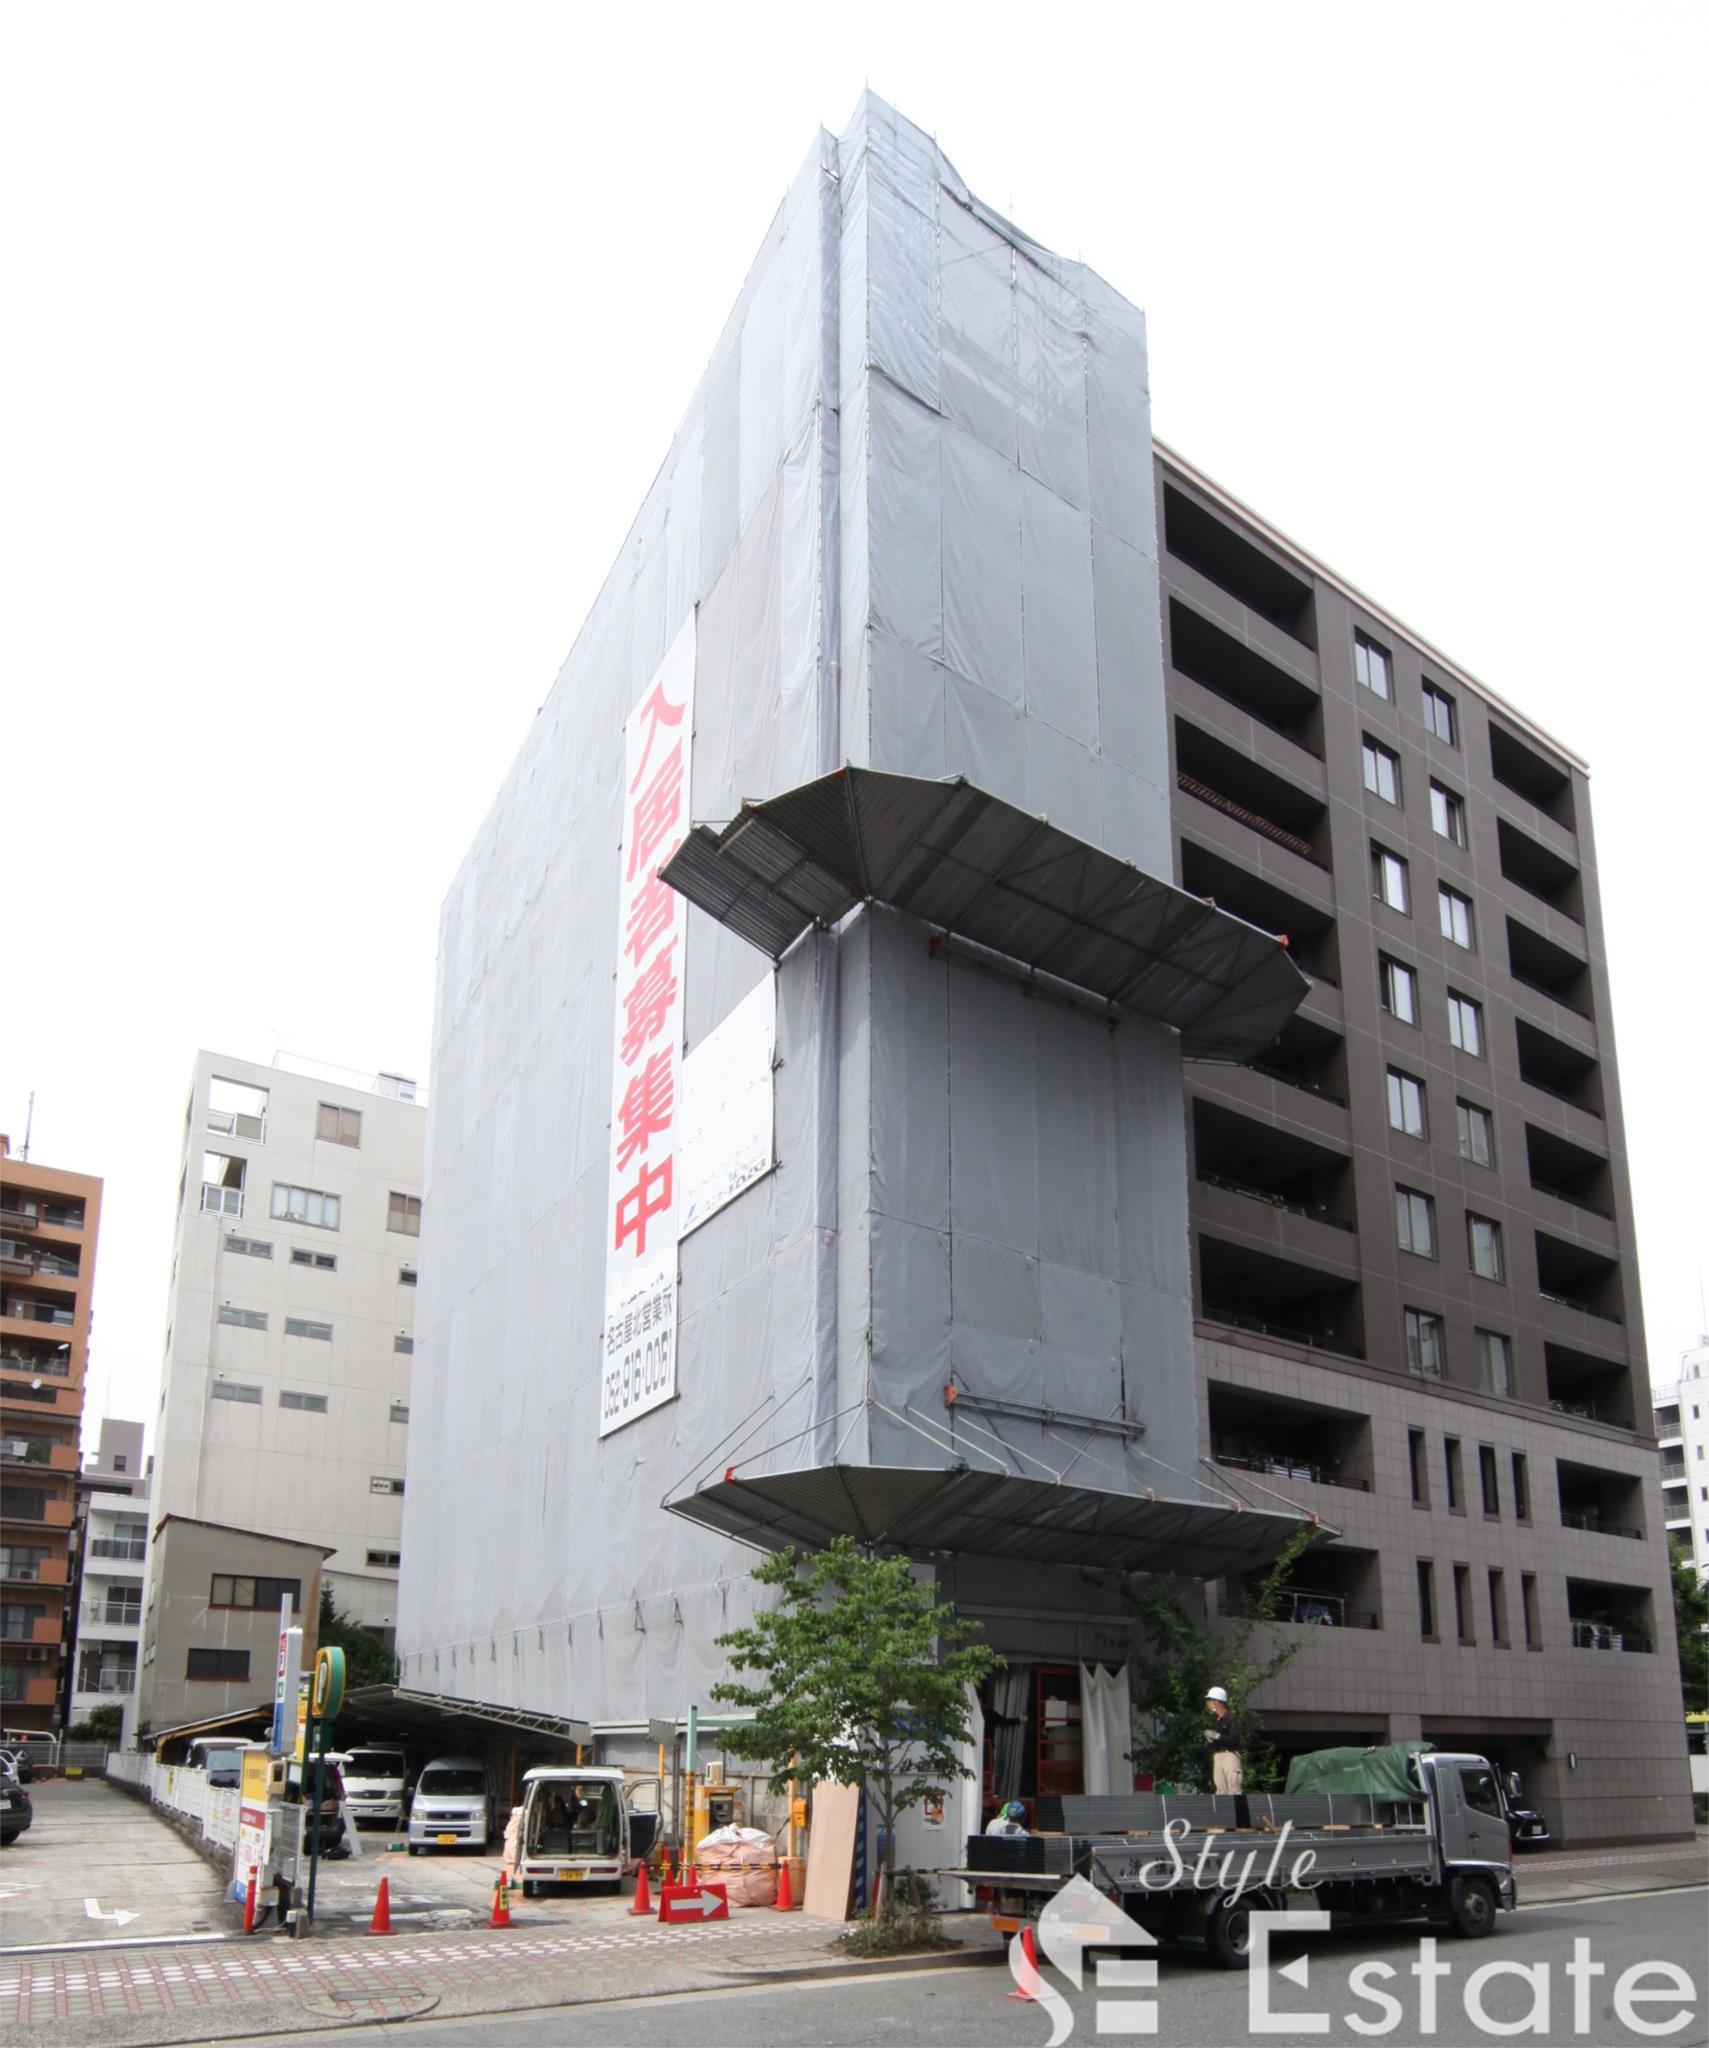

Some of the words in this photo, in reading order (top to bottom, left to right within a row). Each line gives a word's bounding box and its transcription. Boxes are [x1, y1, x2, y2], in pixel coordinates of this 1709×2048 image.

[614, 680, 687, 1258] 入居者募集中
